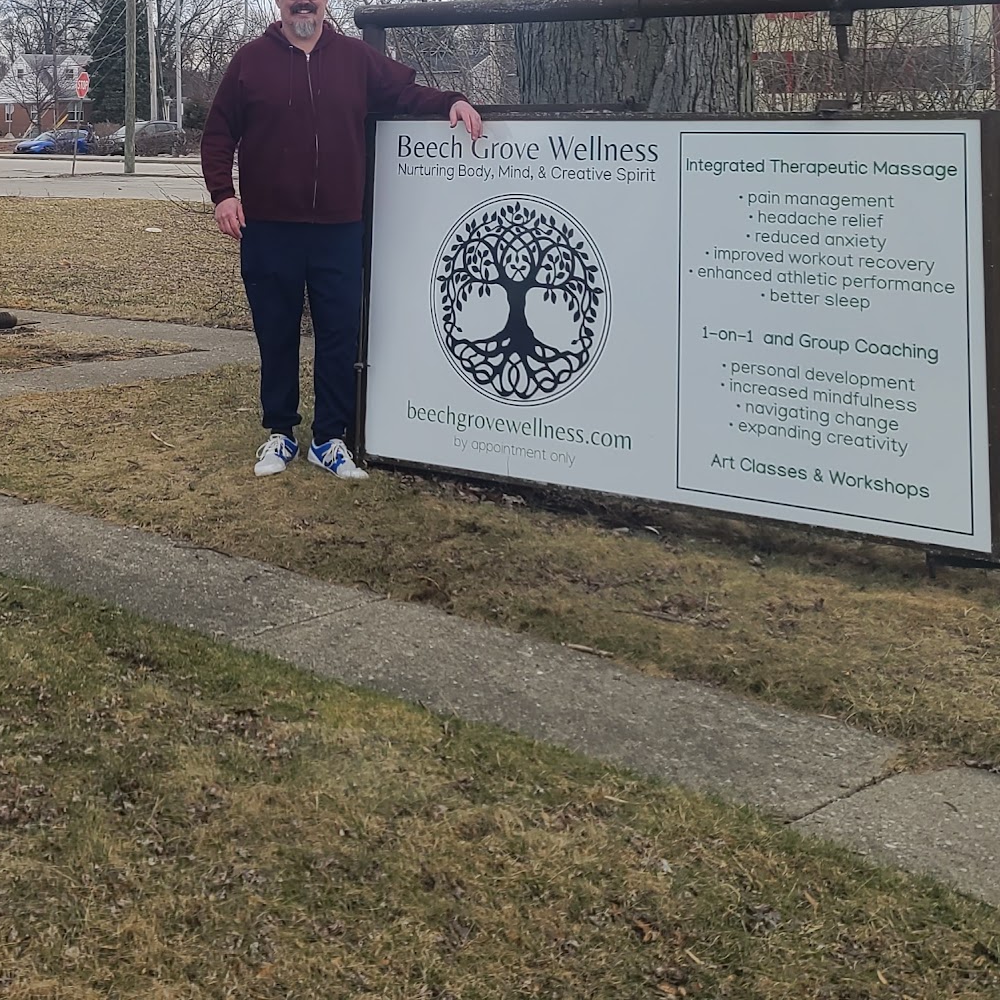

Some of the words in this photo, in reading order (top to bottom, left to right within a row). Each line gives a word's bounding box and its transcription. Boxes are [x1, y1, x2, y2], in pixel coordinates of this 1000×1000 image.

[77, 80, 89, 90] STOP
[398, 134, 462, 159] Beech
[471, 134, 540, 160] Grove
[549, 135, 659, 162] Wellness
[397, 163, 455, 180] Nurturing
[457, 164, 495, 181] Body,
[498, 165, 535, 180] Mind,
[538, 167, 547, 180] &
[551, 167, 612, 181] Creative
[617, 167, 656, 184] Spirit
[685, 157, 765, 176] Integrated
[769, 158, 868, 177] Therapeutic
[873, 161, 958, 180] Massage
[748, 191, 781, 207] pain
[785, 192, 895, 210] management
[758, 210, 837, 227] headache
[842, 213, 884, 229] relief
[755, 230, 820, 246] reduced
[825, 233, 887, 252] anxiety
[713, 247, 784, 265] improved
[788, 253, 854, 268] workout
[858, 257, 935, 275] recovery
[697, 266, 772, 282] enhanced
[777, 271, 838, 286] athletic
[842, 274, 956, 295] performance
[770, 289, 821, 306] better
[824, 293, 871, 312] sleep
[701, 326, 754, 343] 1-on-1
[764, 332, 794, 348] and
[799, 333, 850, 354] Group
[855, 338, 939, 364] Coaching
[731, 361, 800, 380] personal
[805, 367, 915, 392] development
[730, 378, 808, 399] increased
[813, 389, 917, 412] mindfulness
[407, 400, 632, 450] beechgrovewellness.com
[746, 402, 830, 426] navigating
[835, 411, 900, 433] change
[453, 436, 468, 451] by
[471, 438, 546, 460] appointment
[550, 450, 576, 467] only
[738, 420, 822, 446] expanding
[827, 429, 909, 457] creativity
[711, 453, 735, 471] Art
[739, 456, 808, 481] Classes
[814, 468, 823, 482] &
[829, 470, 931, 499] Workshops
